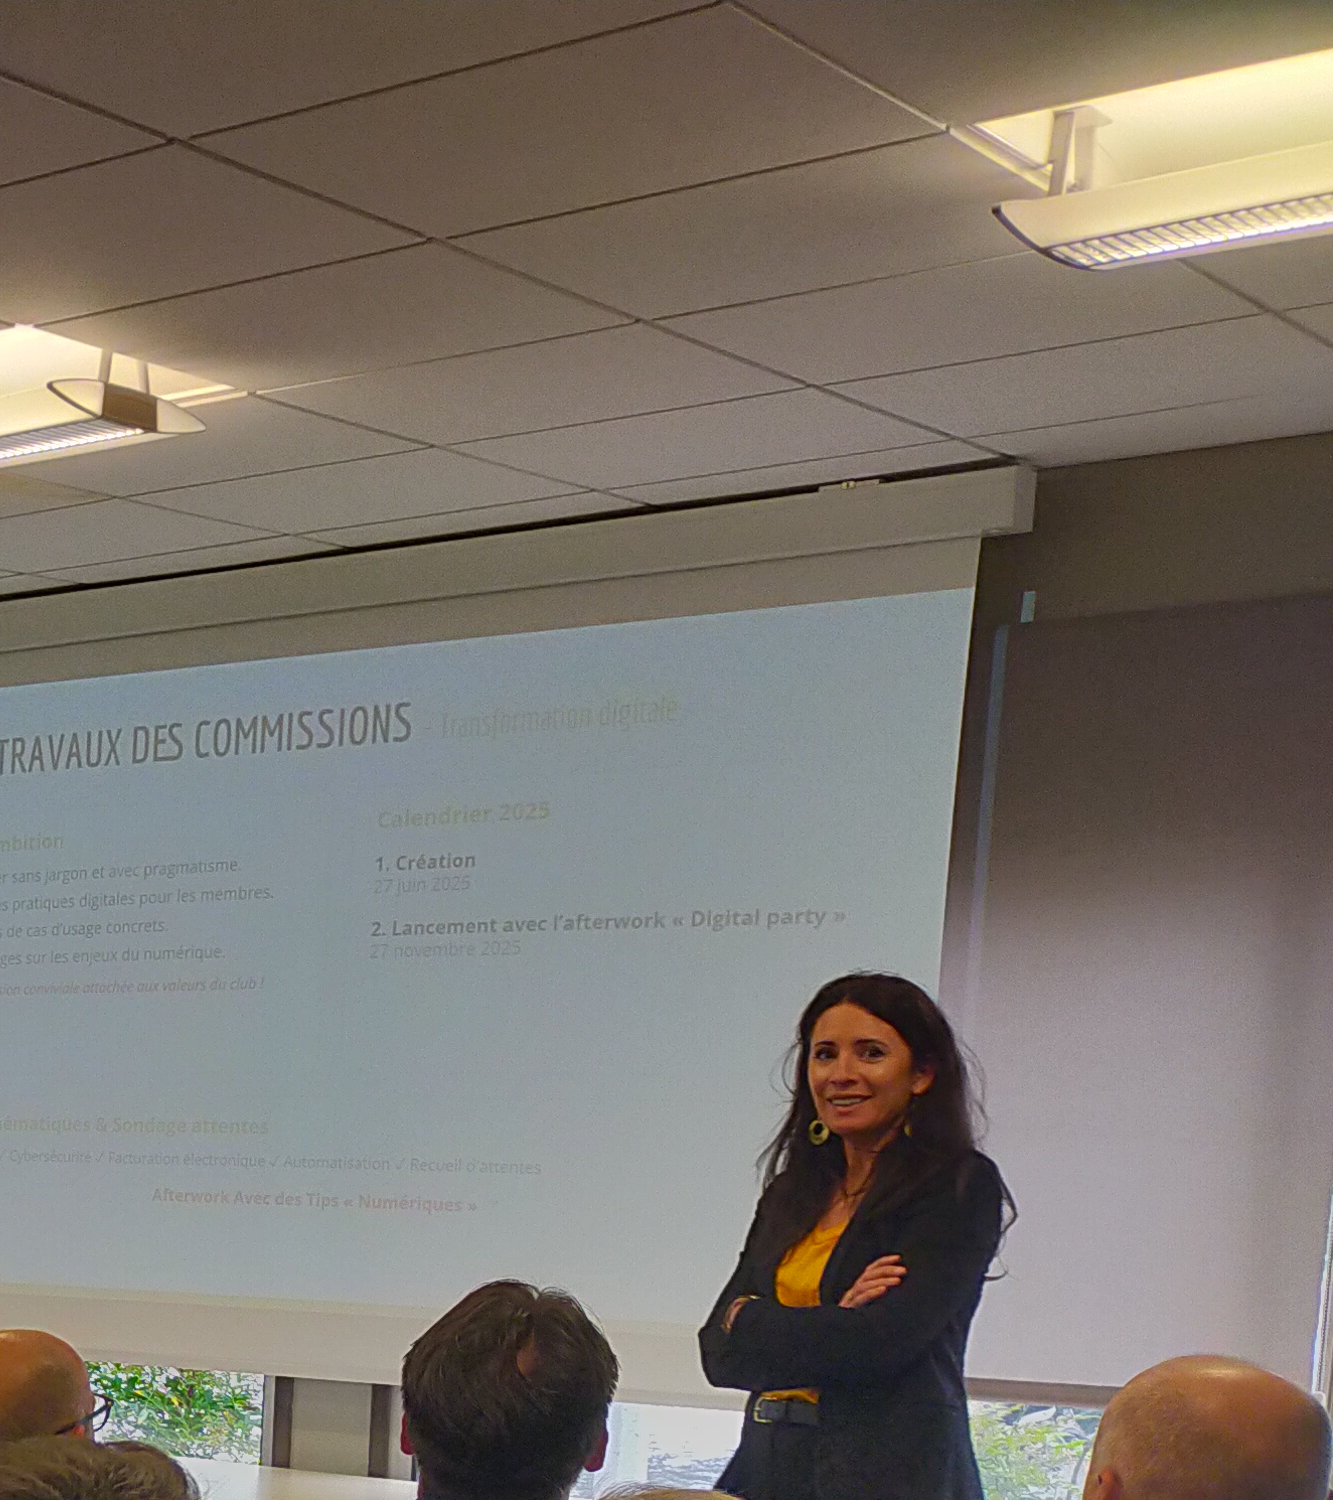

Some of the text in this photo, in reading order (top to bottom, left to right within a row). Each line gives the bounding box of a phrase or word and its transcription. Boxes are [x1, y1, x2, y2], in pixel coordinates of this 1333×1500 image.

[132, 722, 183, 764] DES
[195, 702, 412, 758] COMMISSIONS
[378, 803, 550, 828] Calendrier 2025
[11, 871, 41, 883] sans
[44, 868, 87, 885] jargon
[92, 867, 104, 879] et
[108, 866, 139, 878] avec
[144, 859, 241, 880] pragmatisme.
[376, 853, 476, 872] 1. Création
[374, 875, 471, 897] 27 juin 2025
[12, 895, 74, 914] pratiques
[79, 892, 134, 911] digitales
[139, 893, 172, 908] pour
[177, 889, 195, 903] les
[200, 886, 274, 902] membres.
[7, 925, 22, 938] de
[26, 926, 47, 937] cas
[106, 921, 168, 934] concrets.
[370, 921, 386, 937] 2.
[392, 918, 497, 936] Lancement
[502, 920, 548, 932] avec
[691, 909, 759, 932] Digital
[767, 908, 827, 930] party
[26, 953, 46, 964] sur
[51, 950, 69, 963] les
[73, 950, 117, 966] enjeux
[122, 949, 138, 962] du
[143, 946, 226, 963] numérique.
[482, 940, 521, 956] 2025
[108, 1151, 179, 1165] Facturation
[284, 1156, 390, 1170] Automatisation
[410, 1158, 462, 1173] Recueil
[152, 1189, 229, 1203] Afterwork
[233, 1191, 270, 1205] Avec
[275, 1192, 302, 1206] des
[307, 1193, 339, 1210] Tips
[359, 1195, 463, 1215] Numériques
